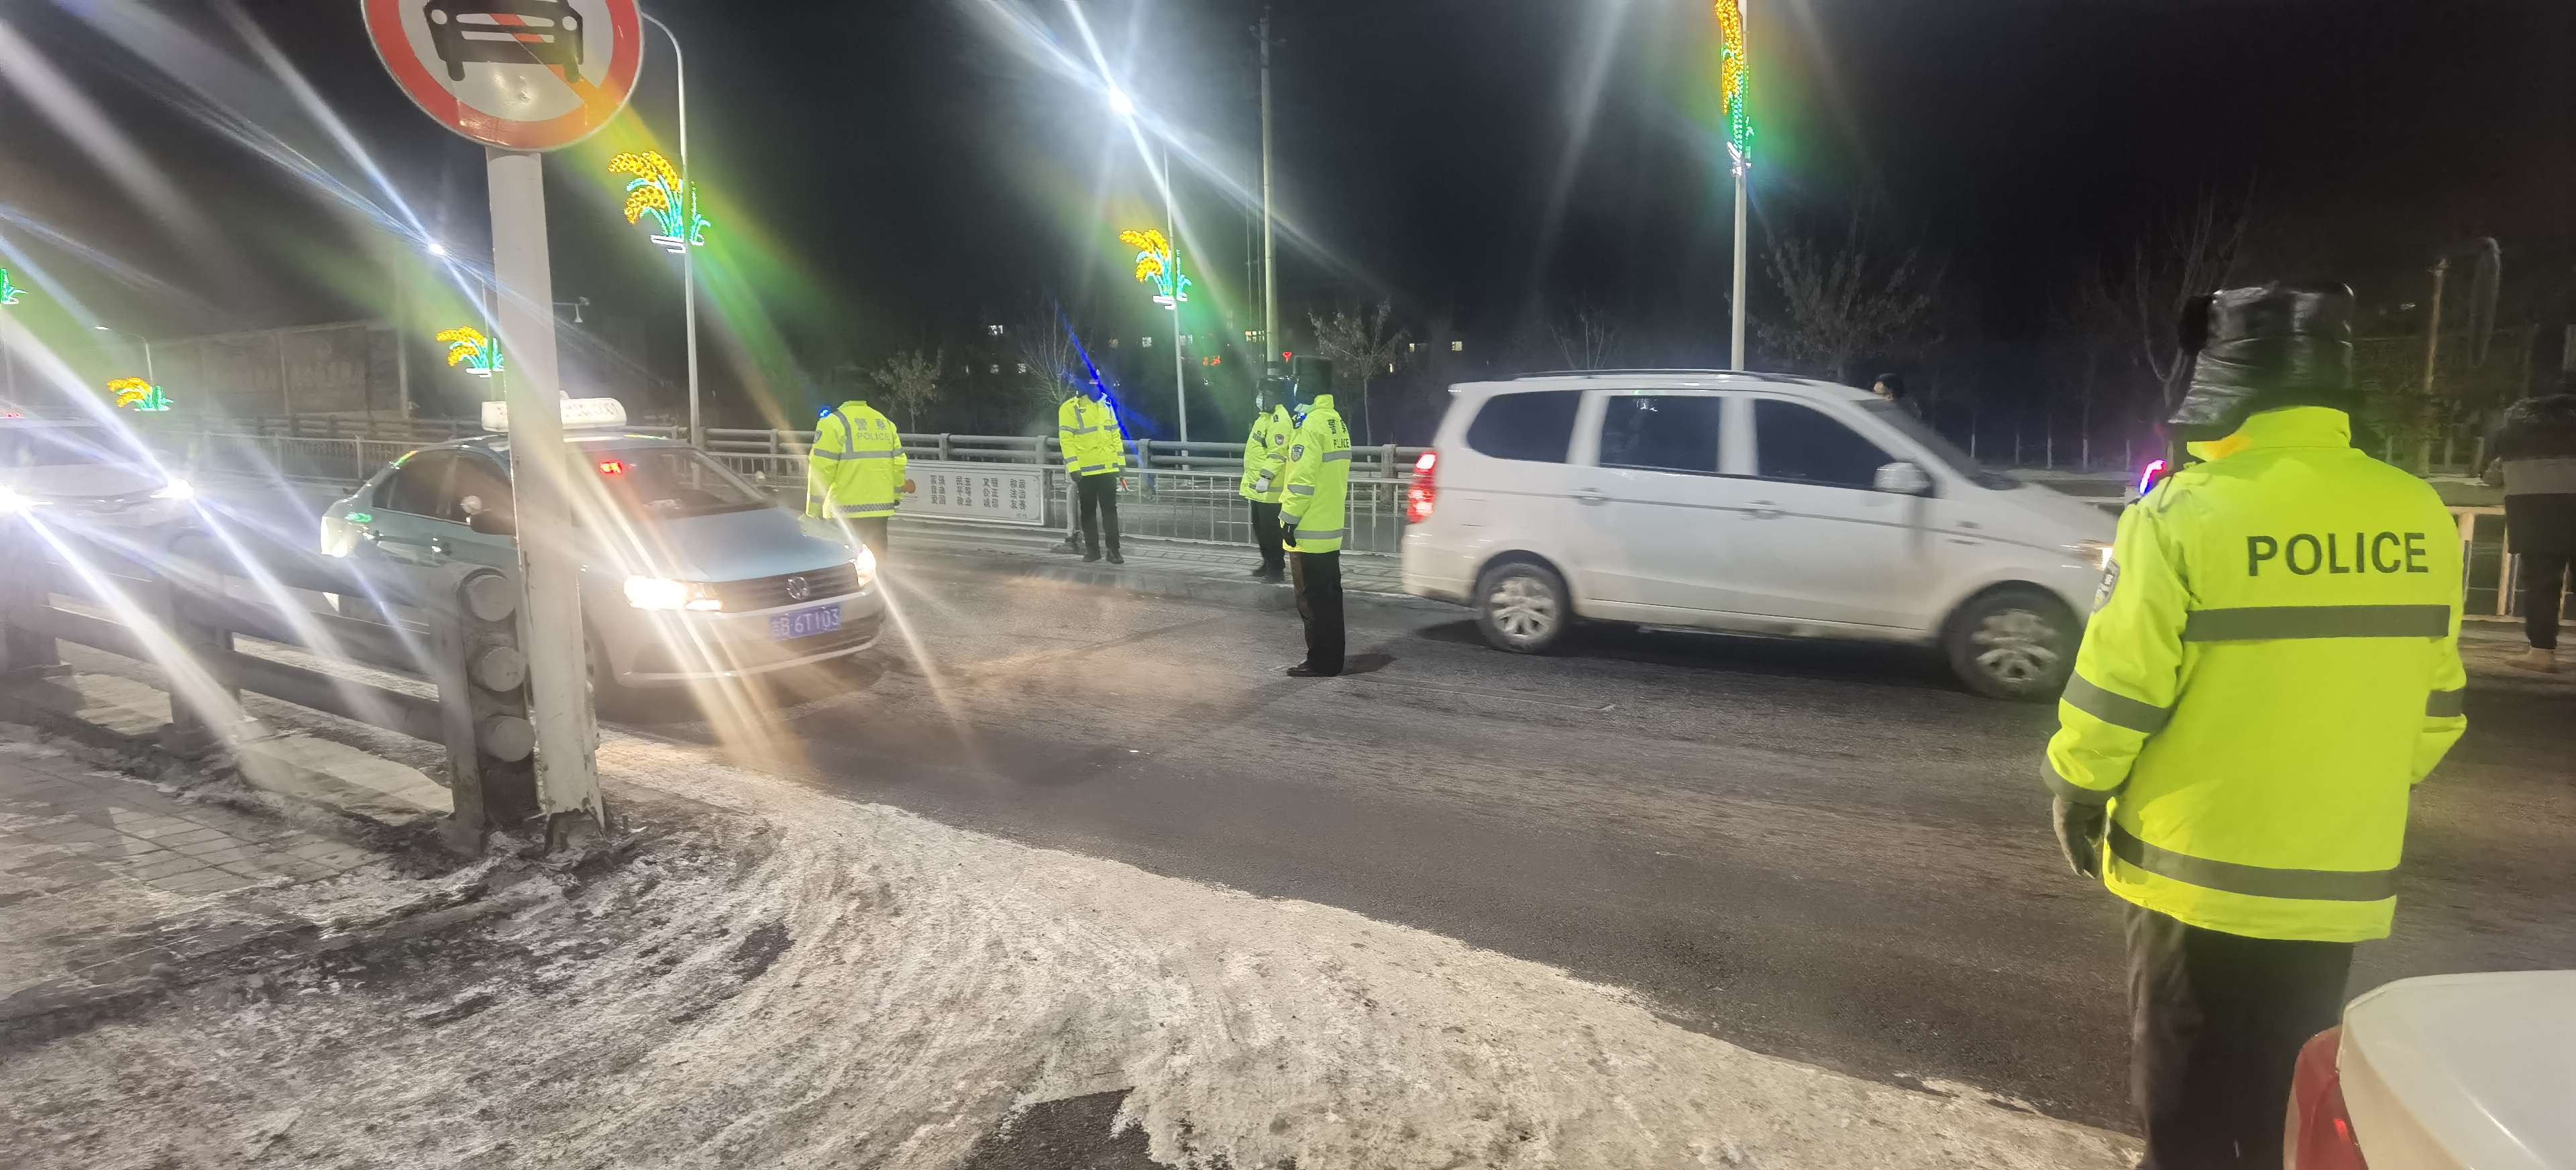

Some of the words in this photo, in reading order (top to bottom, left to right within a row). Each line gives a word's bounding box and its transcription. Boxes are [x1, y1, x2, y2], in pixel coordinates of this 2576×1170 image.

[857, 433, 890, 441] POLICE
[1333, 438, 1350, 449] PICE
[2246, 531, 2429, 577] POLICE
